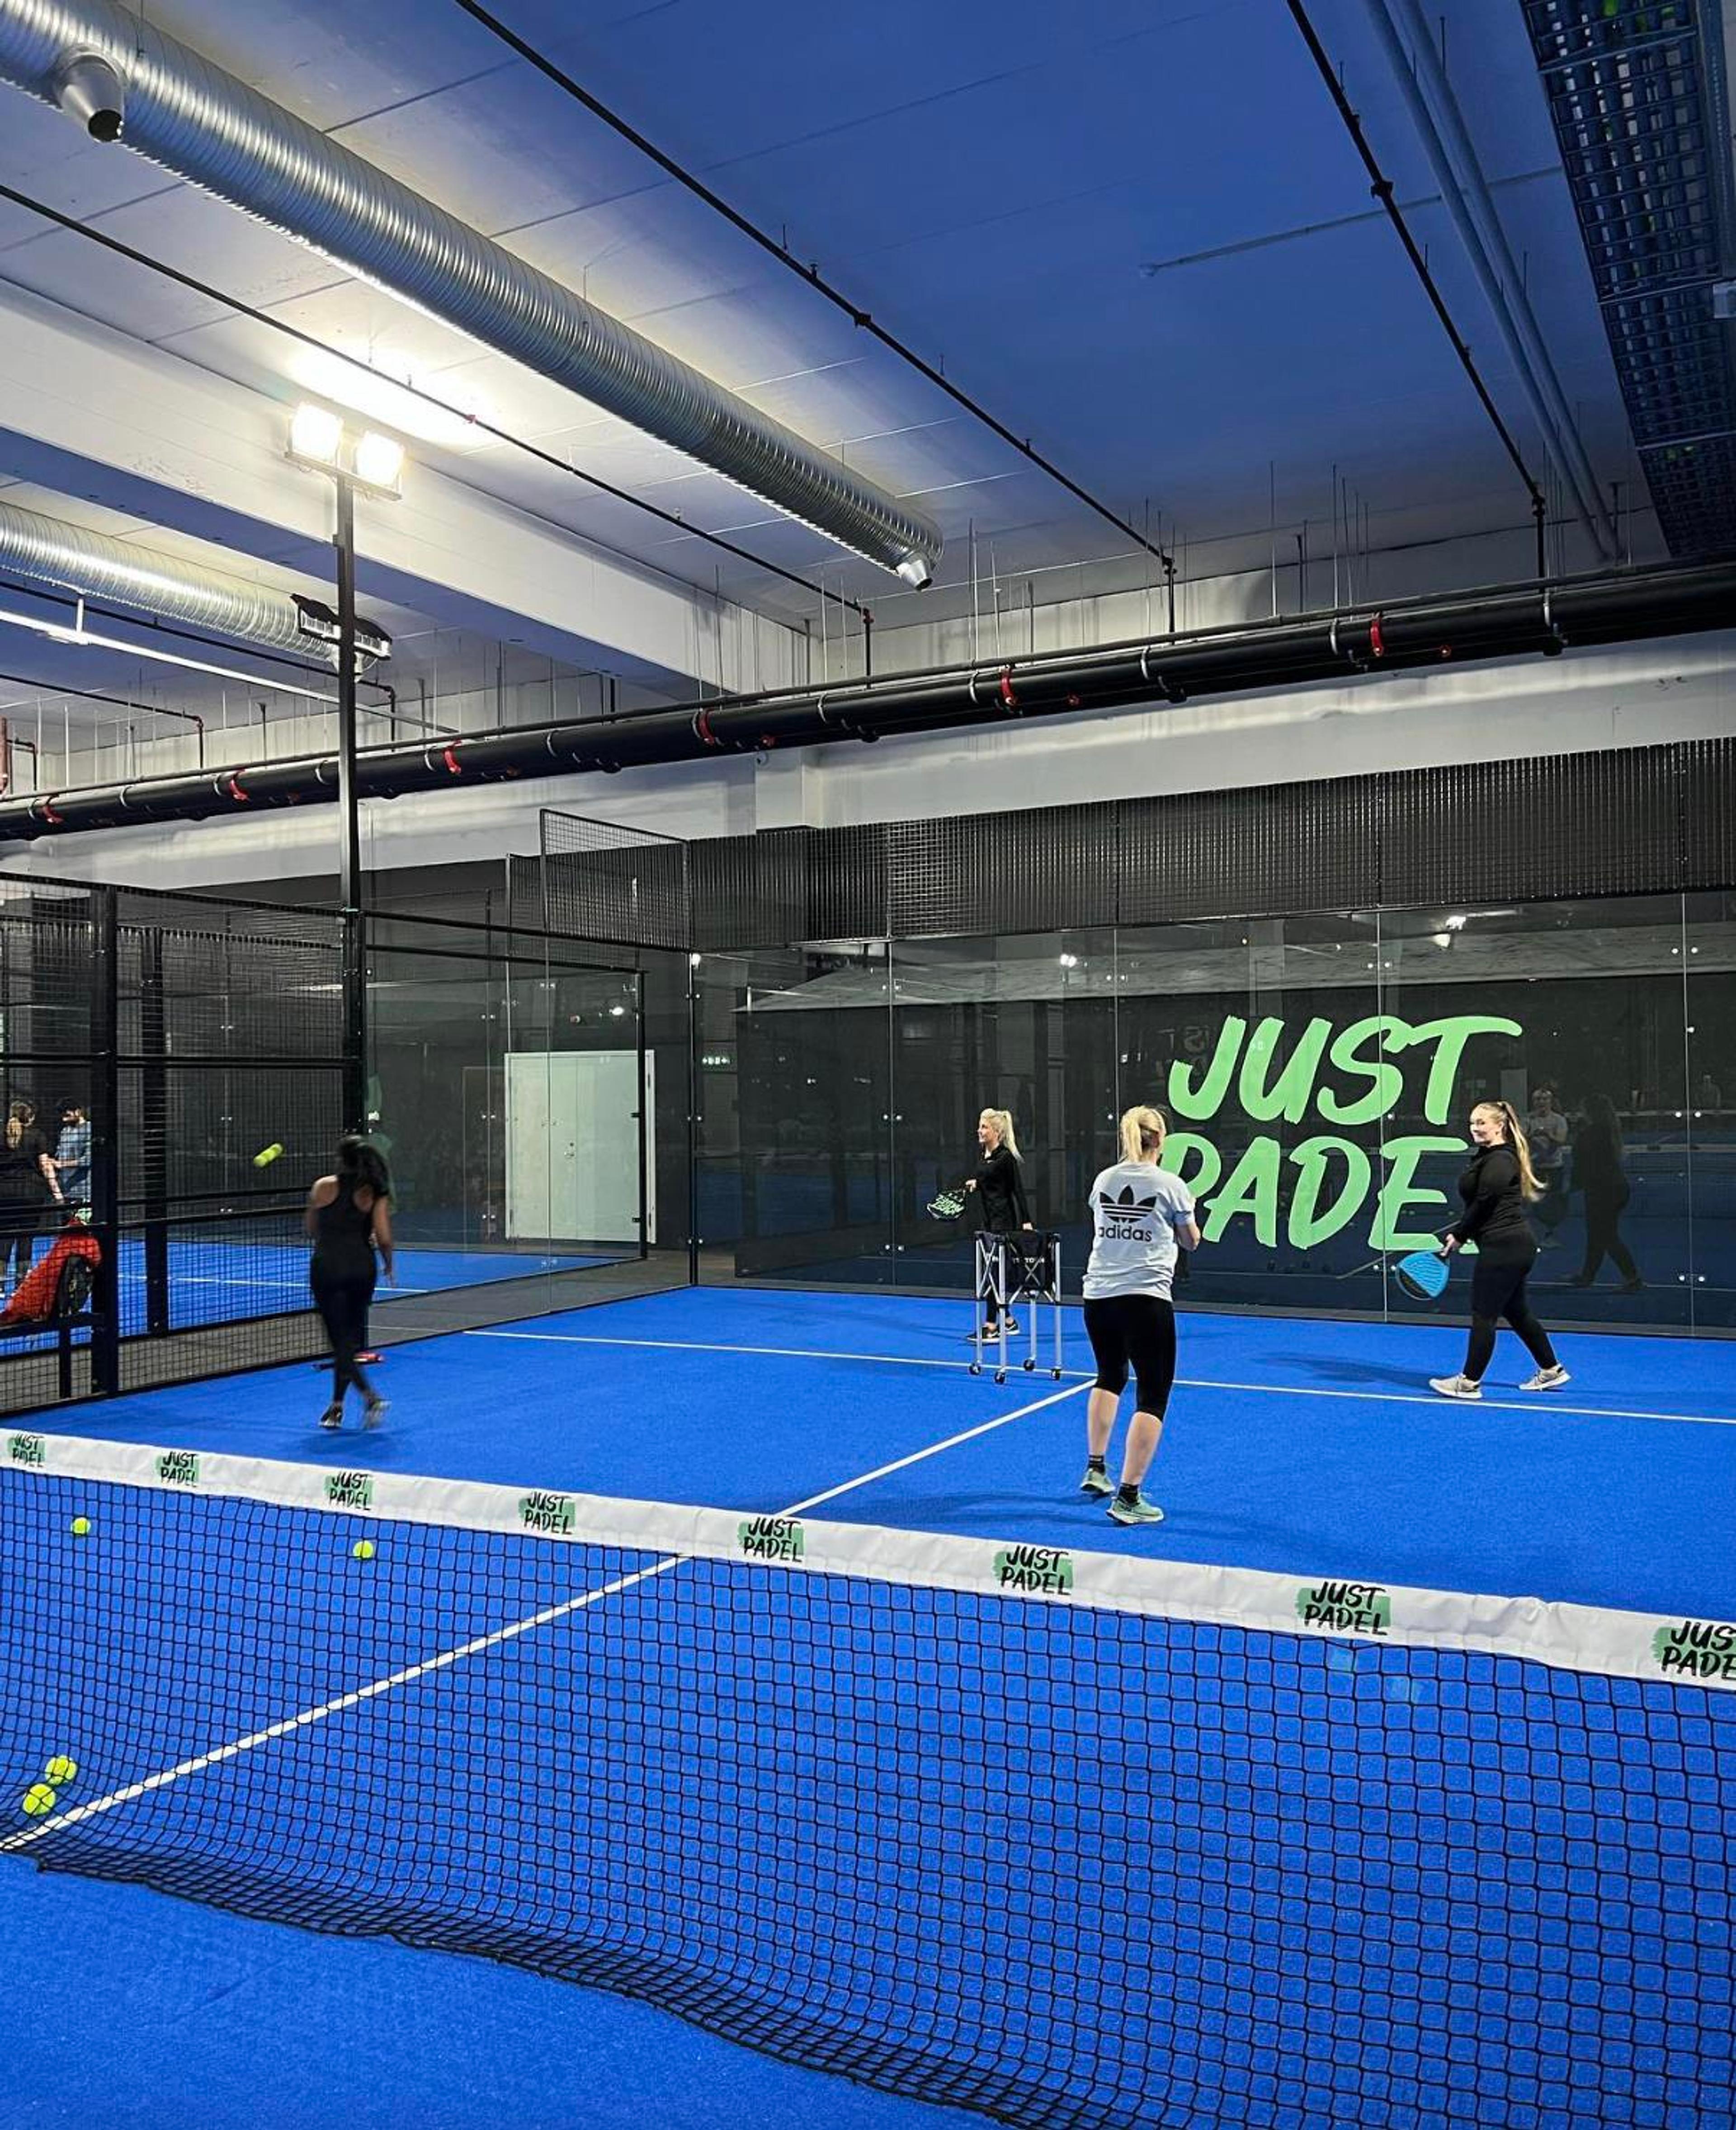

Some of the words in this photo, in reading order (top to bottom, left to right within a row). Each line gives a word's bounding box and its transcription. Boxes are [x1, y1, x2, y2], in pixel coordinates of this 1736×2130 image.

[1169, 1015, 1522, 1125] JUST
[1159, 1133, 1480, 1254] PADE
[1099, 1225, 1152, 1242] adidas
[163, 1451, 198, 1468] JUST
[160, 1466, 197, 1487] PADEL
[332, 1471, 373, 1489] JUST
[330, 1489, 371, 1511] PADEL
[527, 1492, 571, 1512] JUST
[524, 1509, 572, 1535] PADEL
[748, 1517, 801, 1538] JUST
[744, 1536, 802, 1562] PADEL
[1006, 1546, 1068, 1572] JUST
[1001, 1567, 1070, 1595] PADEL
[1311, 1582, 1386, 1609] JUST
[1304, 1604, 1387, 1635] PADEL
[1670, 1621, 1736, 1651] JUS
[1662, 1647, 1736, 1680] PADE
